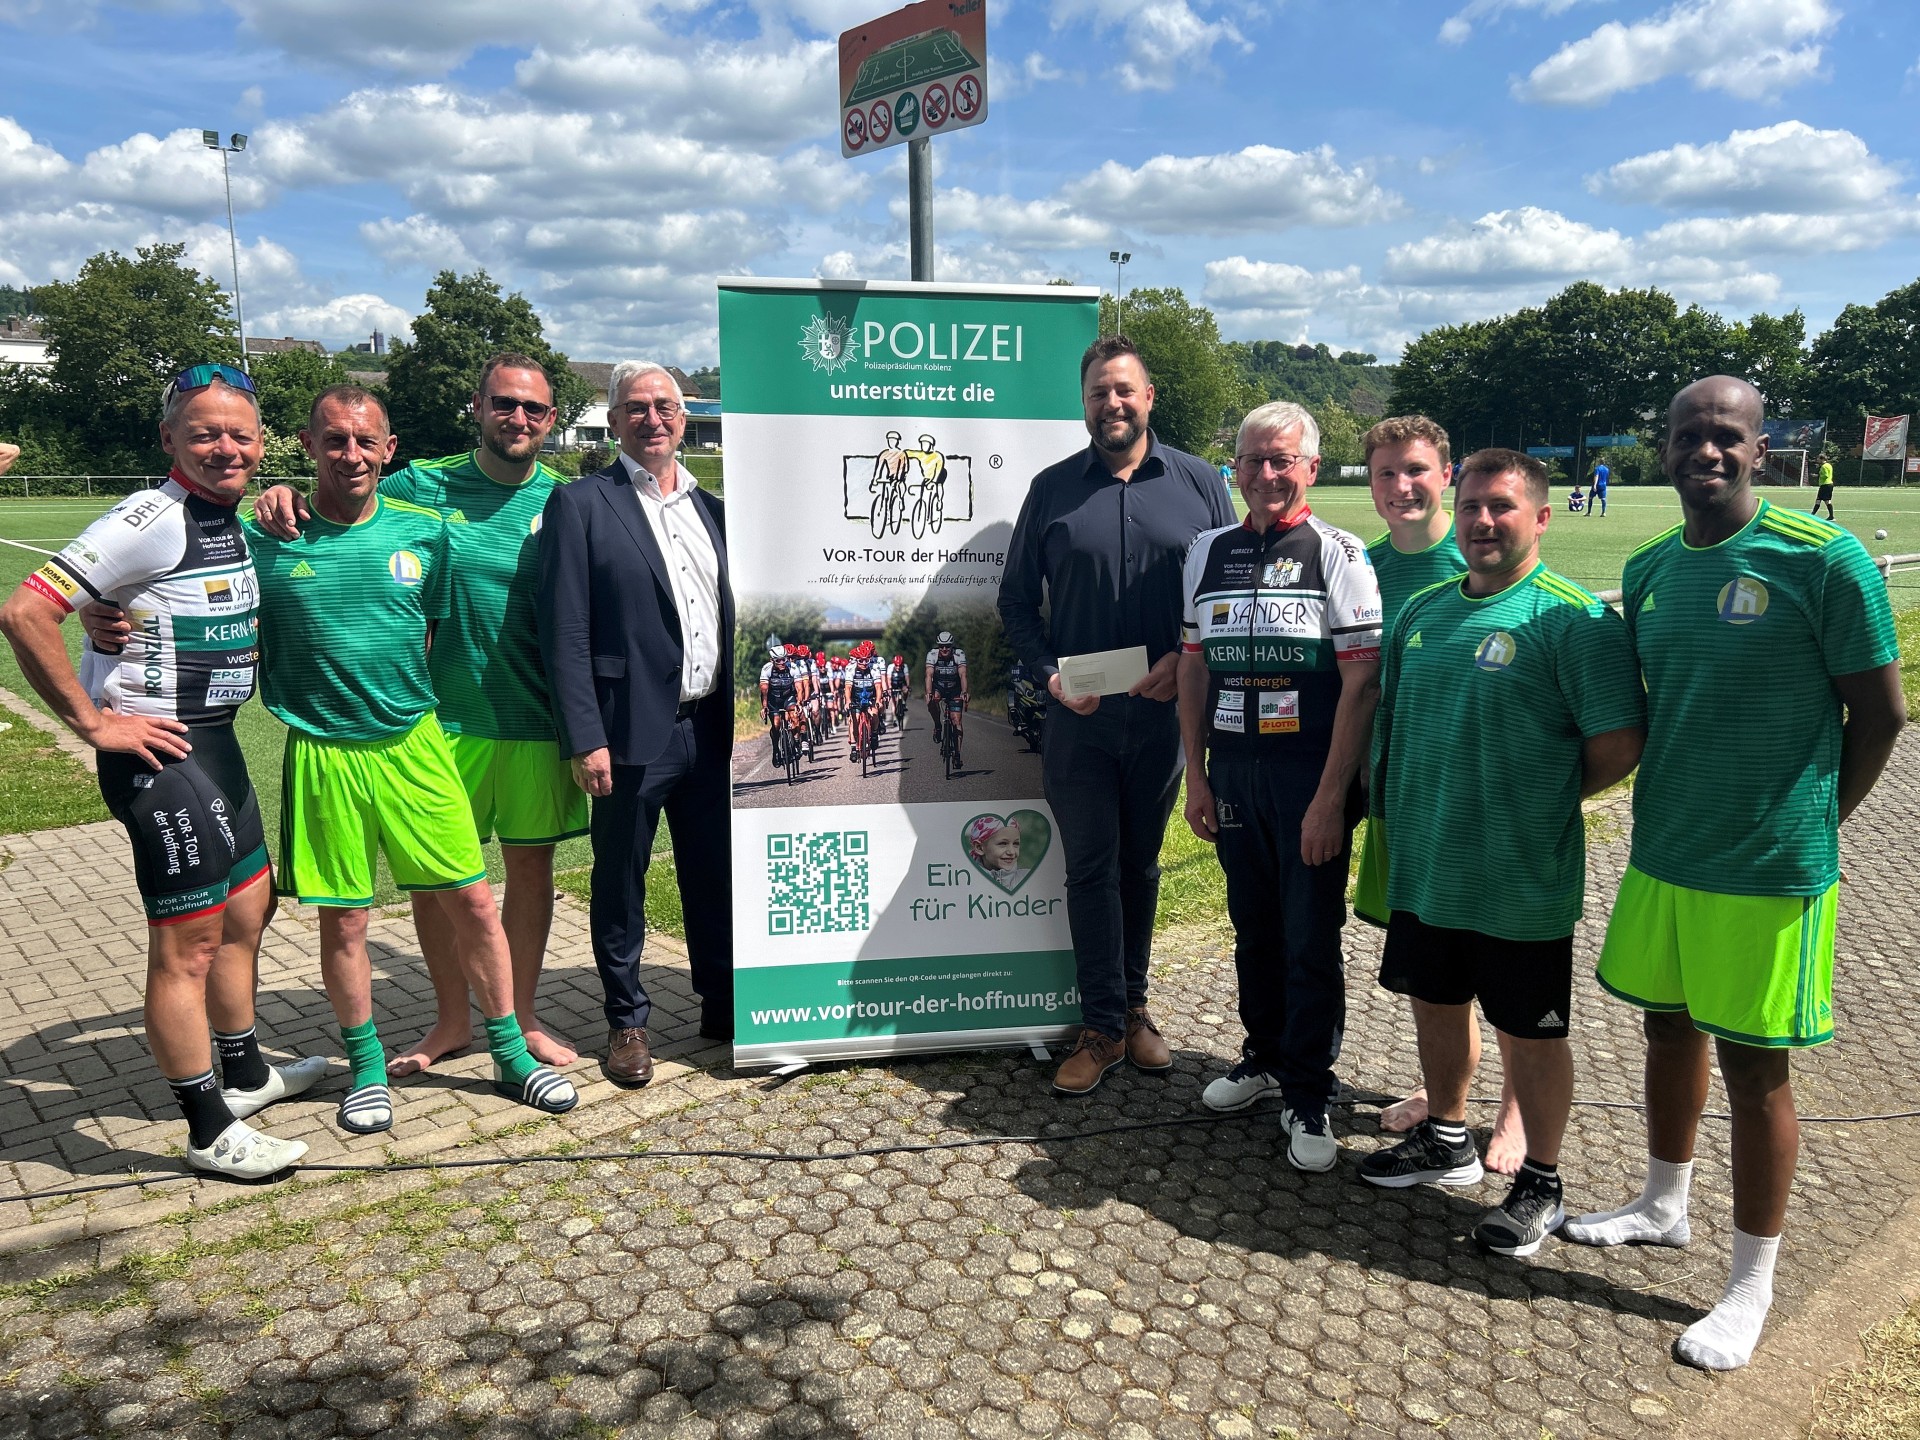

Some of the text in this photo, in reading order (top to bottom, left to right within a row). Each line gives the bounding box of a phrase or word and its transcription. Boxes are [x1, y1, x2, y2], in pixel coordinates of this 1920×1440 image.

[864, 321, 1022, 362] POLIZEI
[864, 361, 952, 372] Polizeipräsidium Koblenz
[830, 381, 995, 402] unterstützt die
[122, 500, 160, 528] DFH
[823, 548, 1005, 566] VOR-TOUR der Hoffnung
[43, 566, 72, 591] BOMAG
[819, 573, 838, 584] rollt
[839, 573, 855, 586] für
[856, 573, 906, 585] krebskranke
[908, 574, 925, 584] und
[927, 573, 988, 587] hilfsbedürftige
[1232, 601, 1306, 625] SANDER
[205, 616, 257, 642] KERN-H
[1209, 625, 1306, 634] www.sander-gruppe.com
[211, 671, 242, 679] EPG
[1224, 675, 1291, 689] westenergie
[208, 689, 250, 699] HAHN
[1215, 714, 1243, 724] HAHN
[1271, 720, 1297, 728] LOTTO
[153, 810, 181, 876] der Hoffnung
[174, 807, 201, 867] VOR-TOUR
[927, 863, 971, 887] Ein
[157, 891, 210, 906] VOR-TOUR
[171, 897, 214, 912] Hoffnung
[909, 893, 1062, 922] für Kinder
[909, 974, 937, 982] QR-Code
[952, 971, 982, 981] gelangen
[982, 970, 1002, 978] direkt
[1537, 1020, 1565, 1028] adidas
